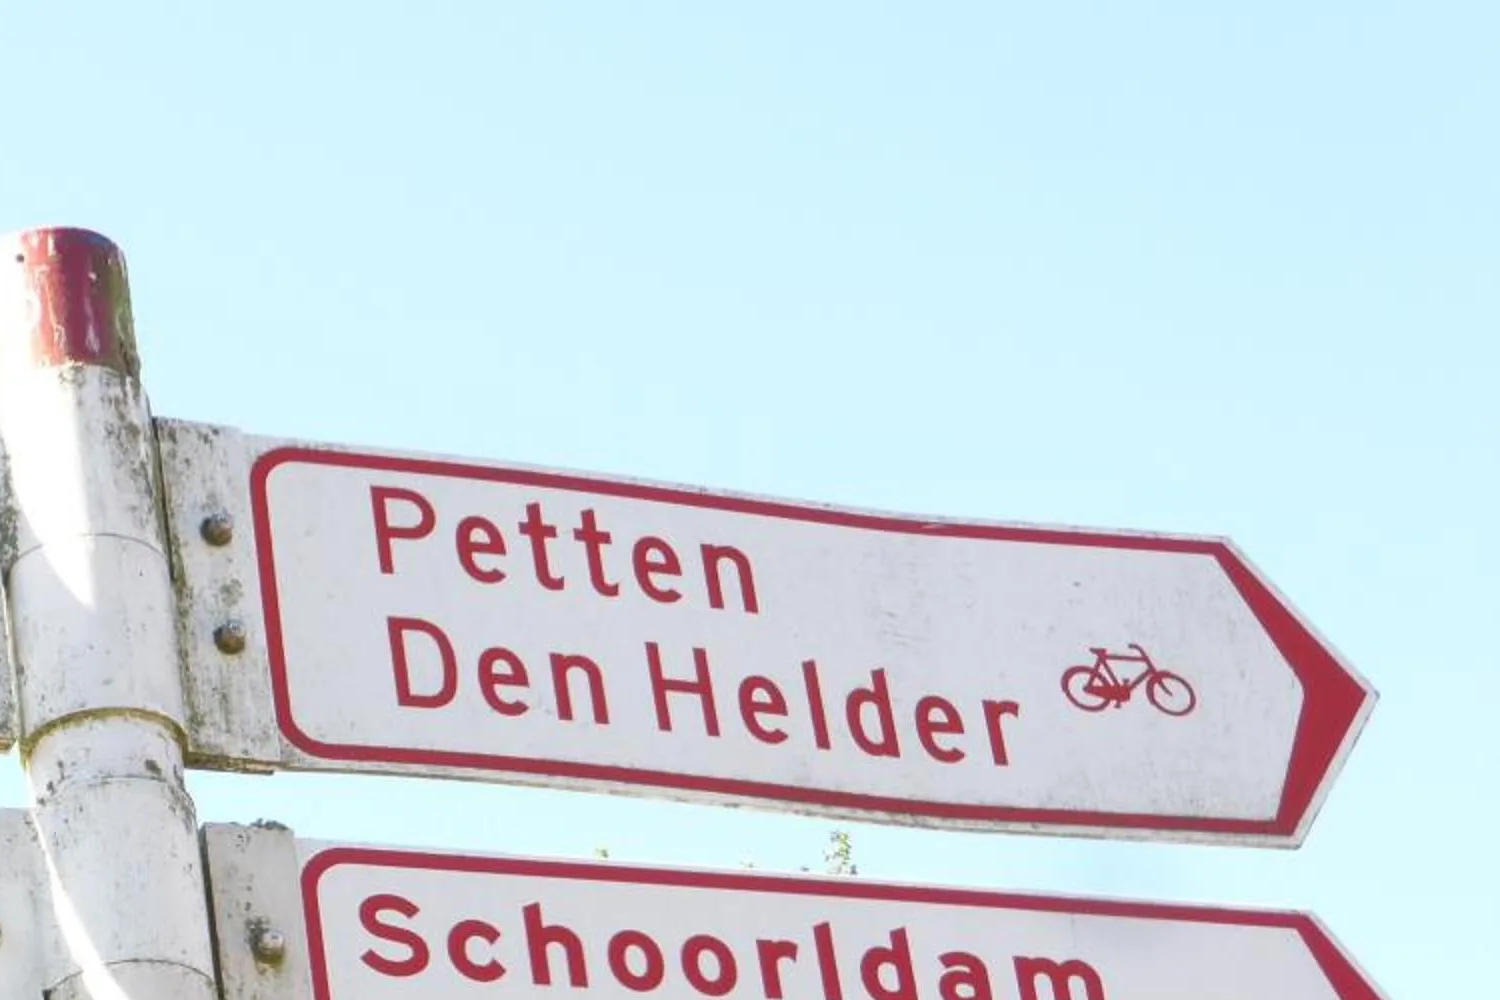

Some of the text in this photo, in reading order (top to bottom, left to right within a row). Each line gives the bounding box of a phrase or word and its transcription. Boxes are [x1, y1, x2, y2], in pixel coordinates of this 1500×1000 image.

[371, 485, 759, 616] Petten
[387, 616, 1020, 767] Den Helder
